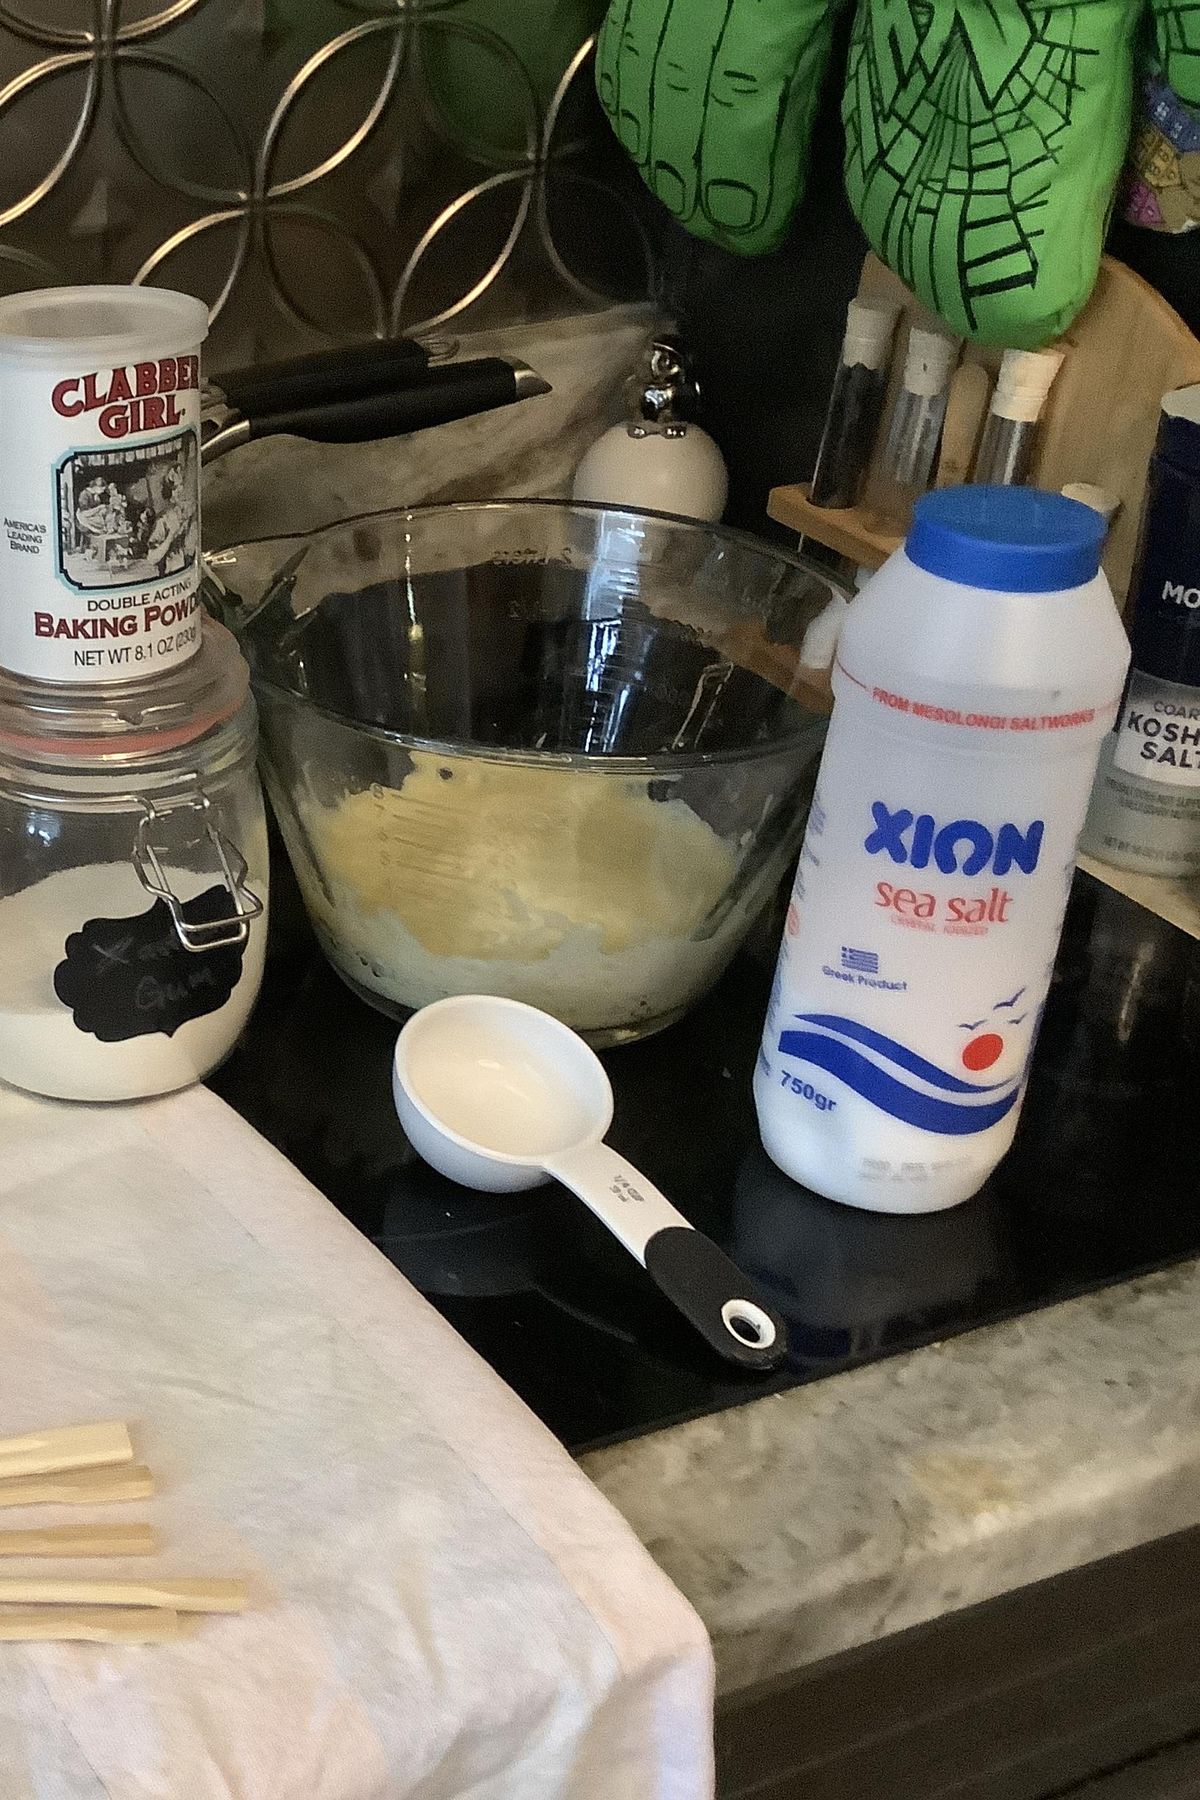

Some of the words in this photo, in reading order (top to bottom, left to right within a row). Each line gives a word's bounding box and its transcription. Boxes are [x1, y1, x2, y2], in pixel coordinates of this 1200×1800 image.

[99, 394, 181, 438] GIRL
[4, 517, 47, 533] AMERICA'S
[7, 529, 42, 543] LEADING
[10, 540, 40, 554] BRAND
[87, 593, 151, 612] DOUBLE
[153, 577, 191, 602] ACTING
[1162, 581, 1200, 609] MO
[34, 611, 138, 639] BAKING
[74, 650, 104, 667] NET
[108, 647, 132, 665] WT
[135, 643, 153, 661] 8.1
[157, 635, 174, 655] OZ
[873, 687, 909, 712] FROM
[1154, 701, 1200, 720] COAR
[1127, 711, 1200, 746] KOSH
[864, 800, 1045, 876] XION
[875, 881, 936, 918] sea
[945, 887, 1014, 923] salt
[822, 965, 854, 983] Greek
[858, 975, 907, 990] Product
[781, 1070, 837, 1113] 750gr
